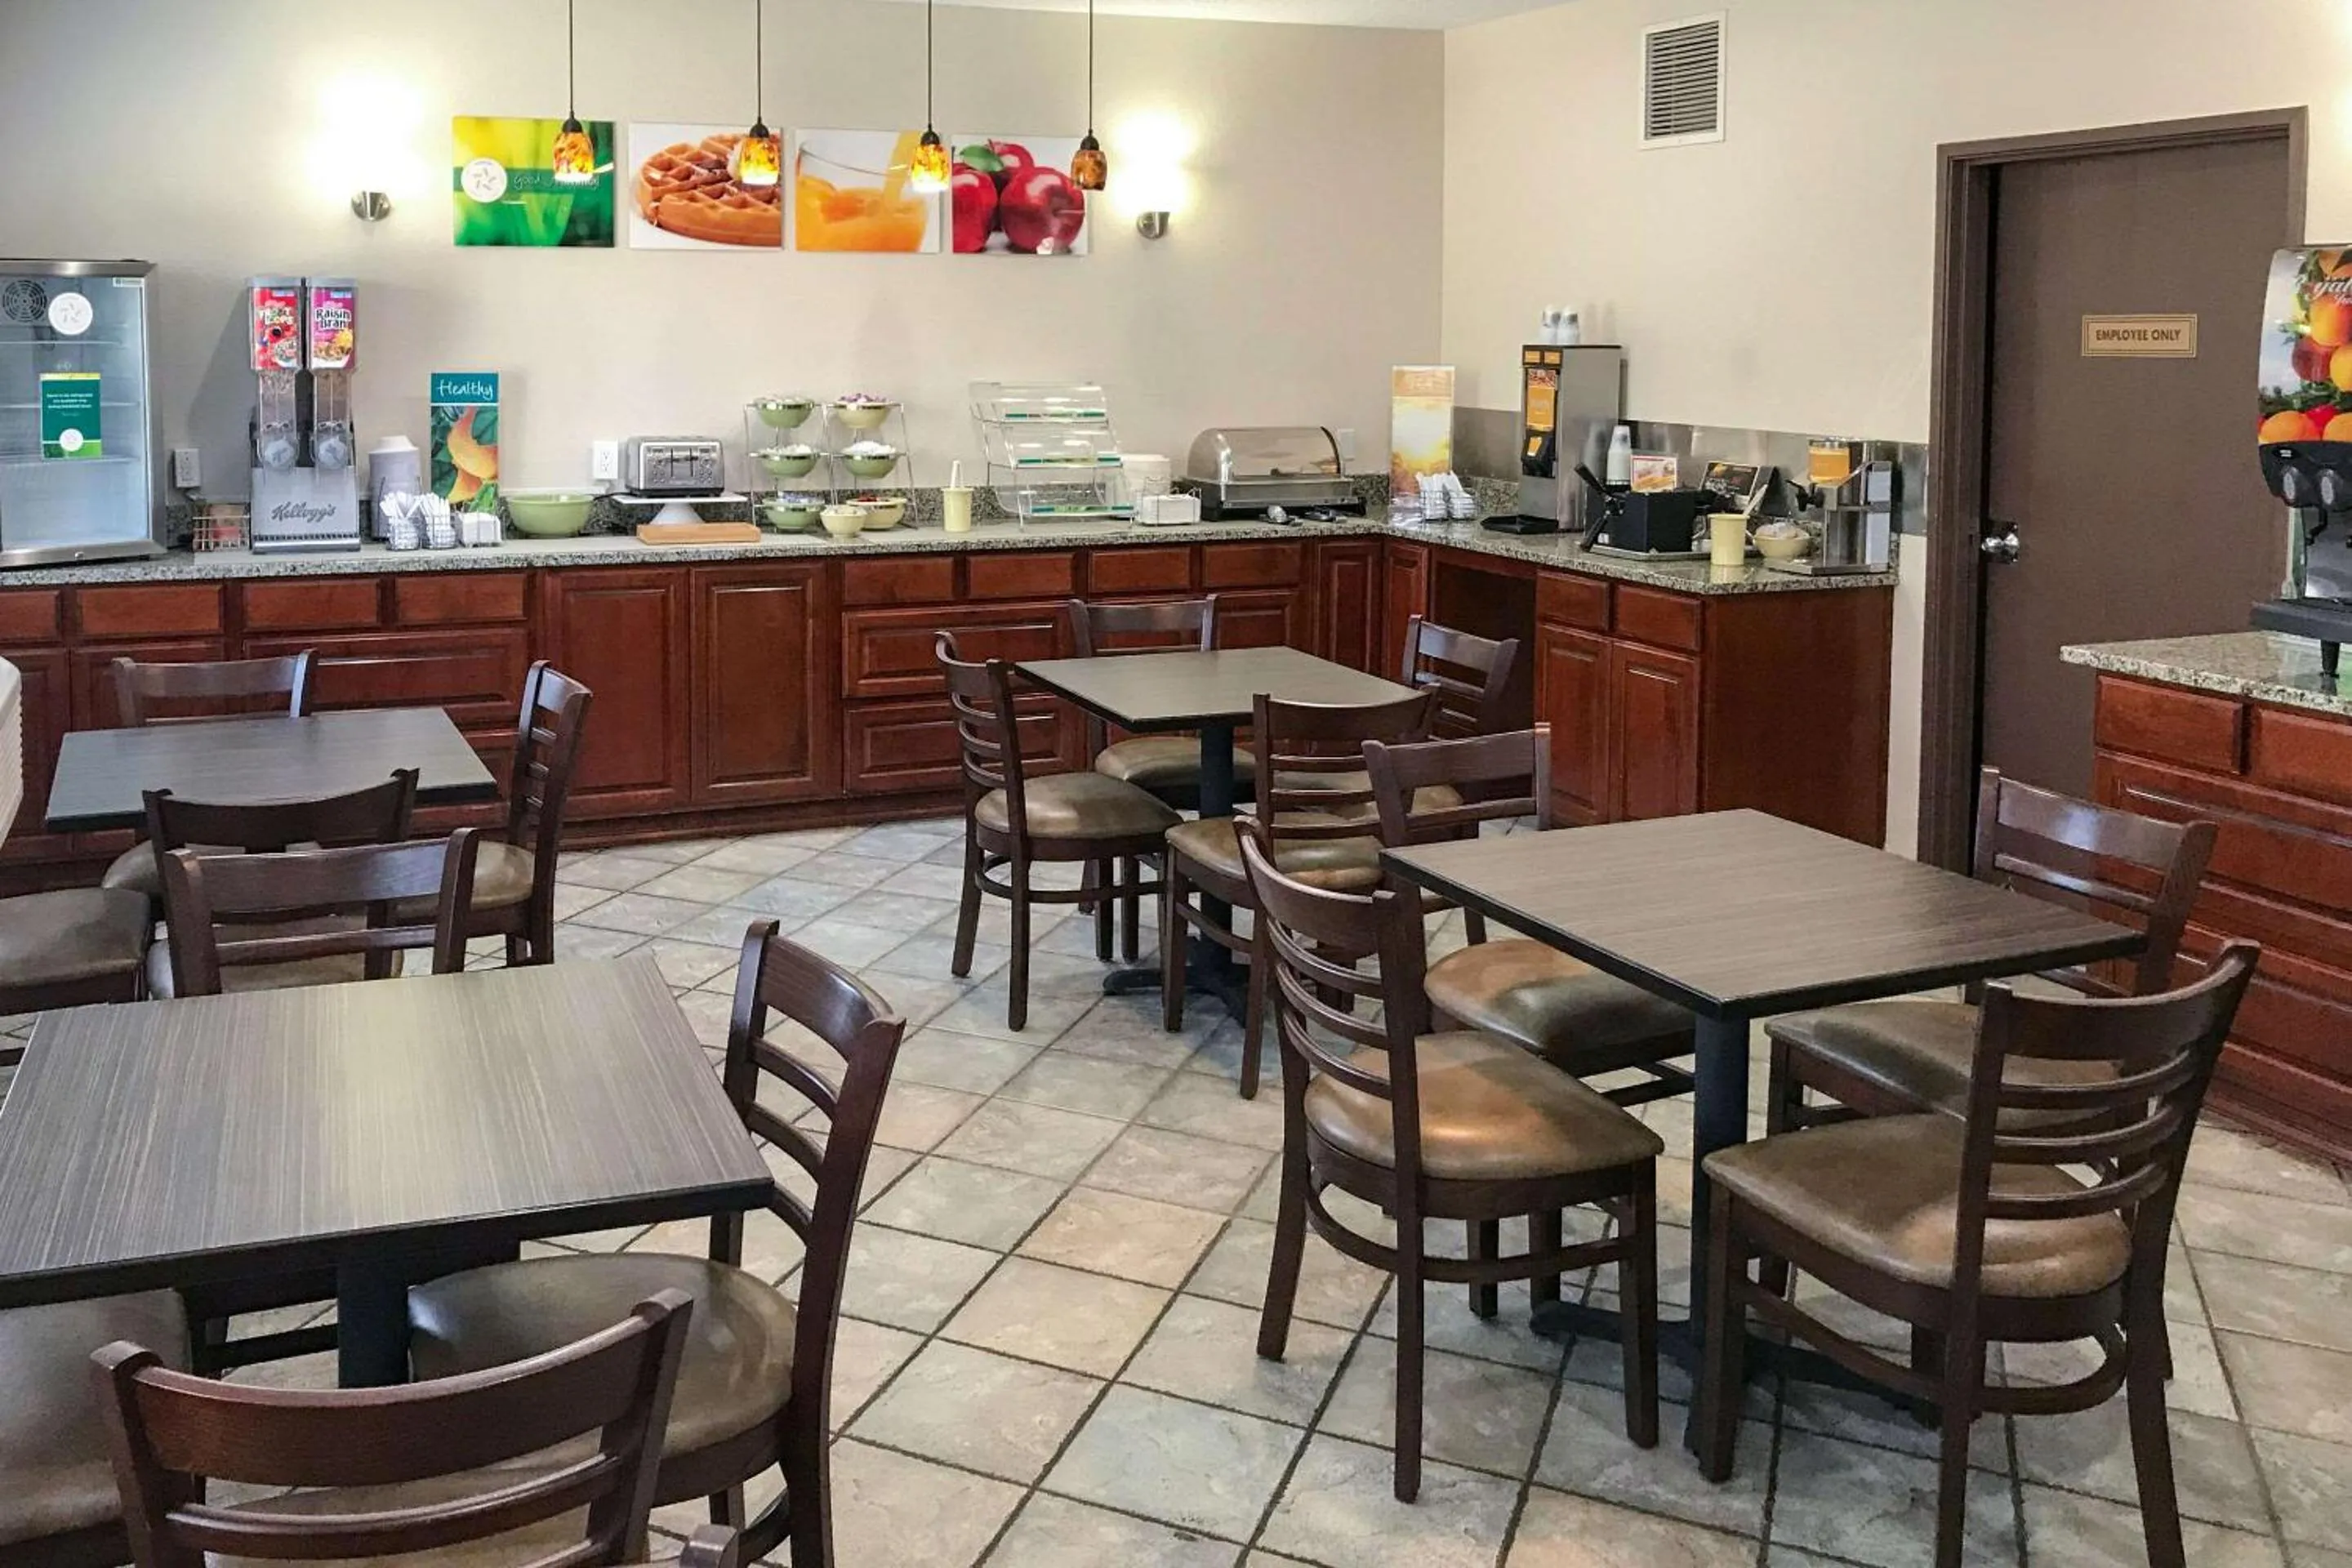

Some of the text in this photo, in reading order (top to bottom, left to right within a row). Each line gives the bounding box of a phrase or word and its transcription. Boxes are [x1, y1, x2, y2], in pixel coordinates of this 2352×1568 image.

[315, 307, 350, 320] Raisin
[2096, 329, 2181, 341] EMPLOYEE ONLY
[436, 379, 492, 400] Healthy
[271, 501, 336, 523] Kellogg's
